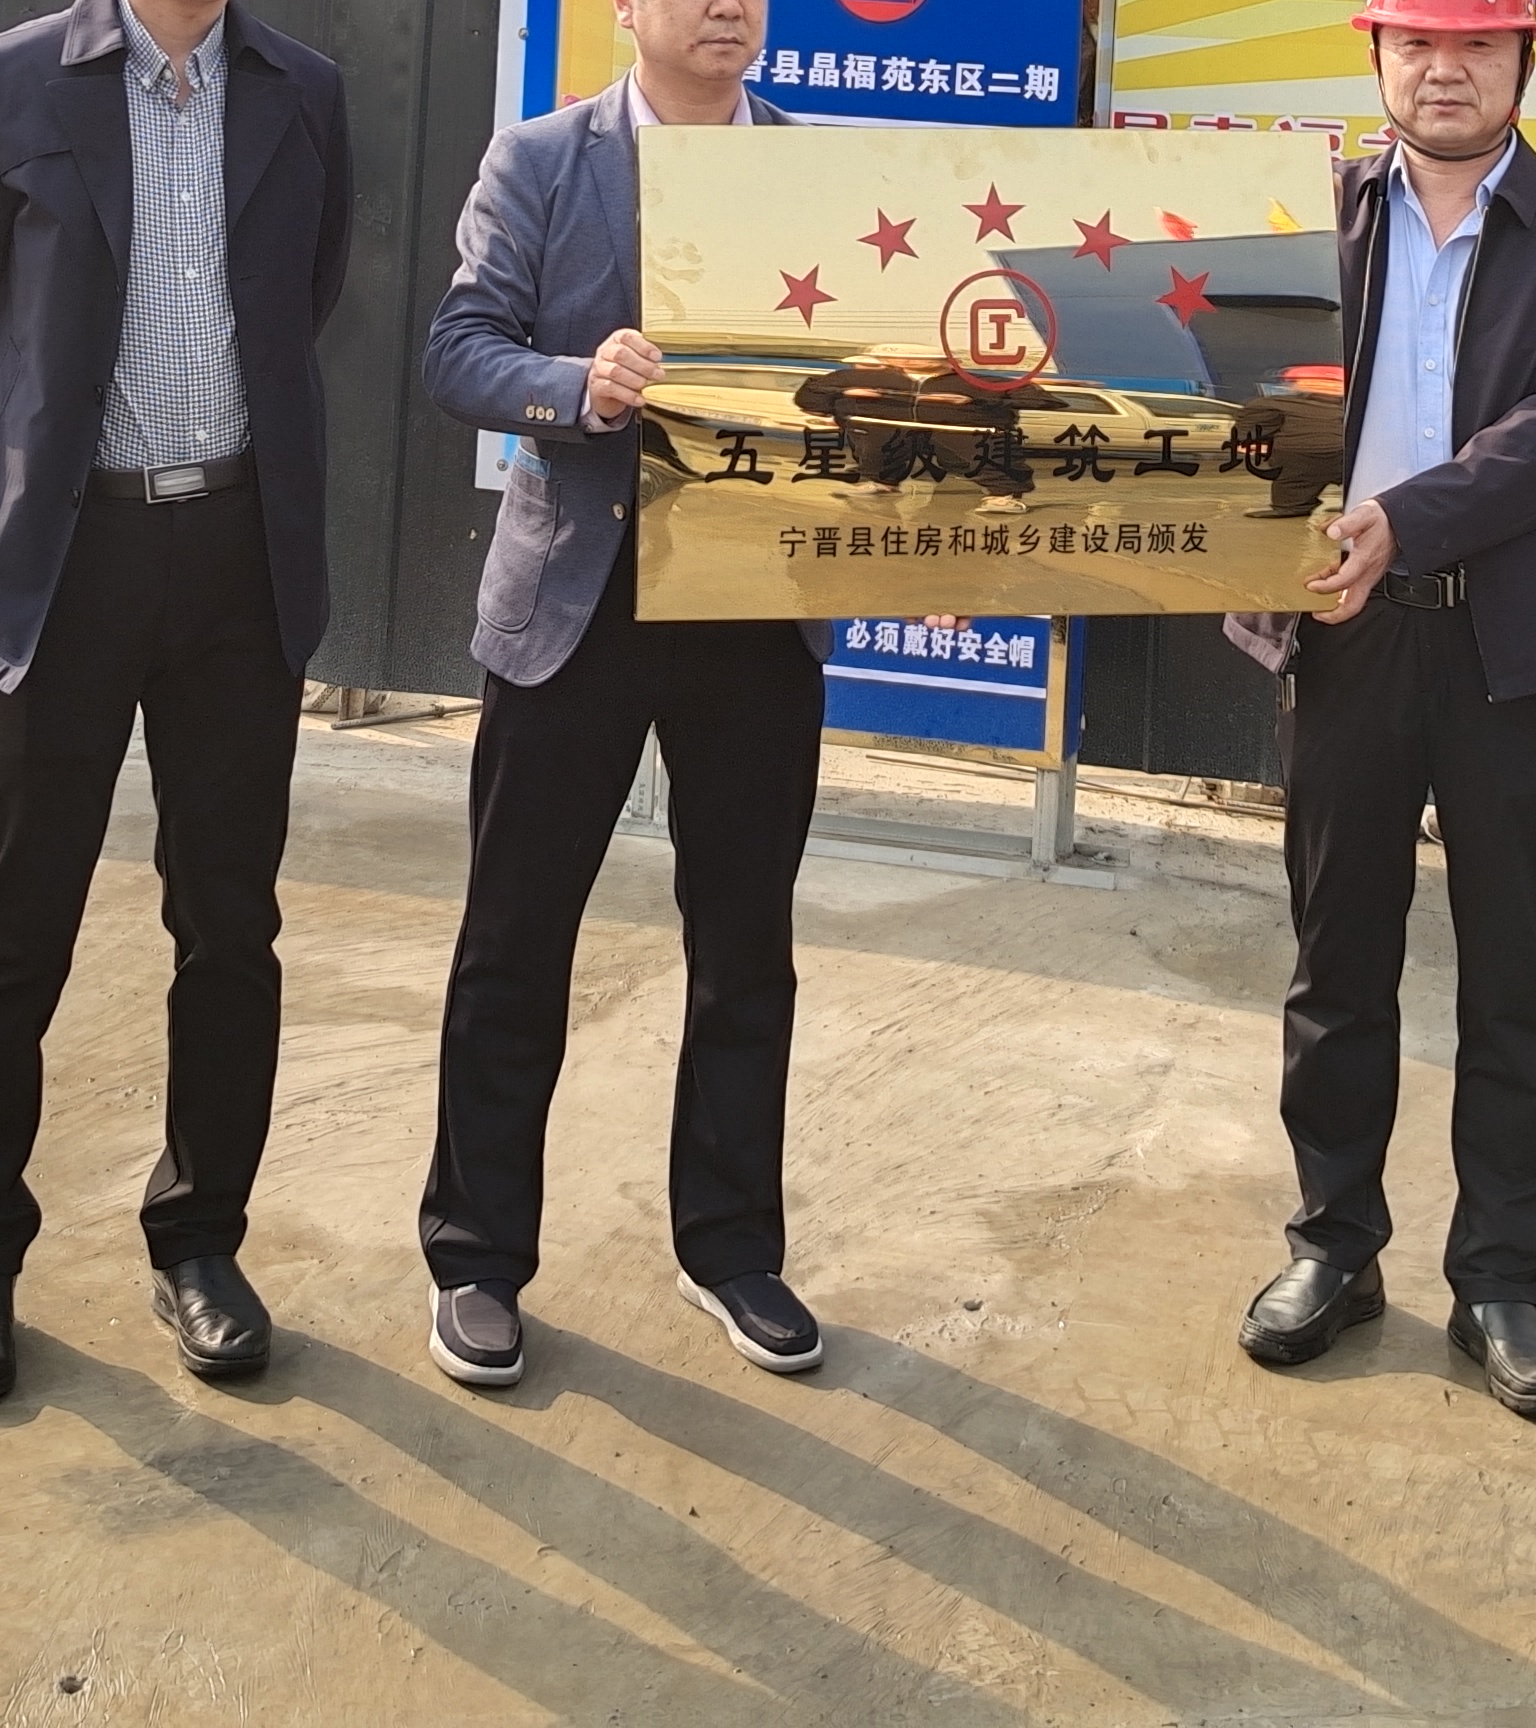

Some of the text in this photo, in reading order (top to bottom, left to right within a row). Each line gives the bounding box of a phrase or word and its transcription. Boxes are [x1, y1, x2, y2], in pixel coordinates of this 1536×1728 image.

[704, 423, 1284, 484] 五星级建筑工地
[779, 522, 1209, 558] 宁晋县住房和城乡建设局颁发
[846, 618, 1035, 668] 必须戴好安全帽
